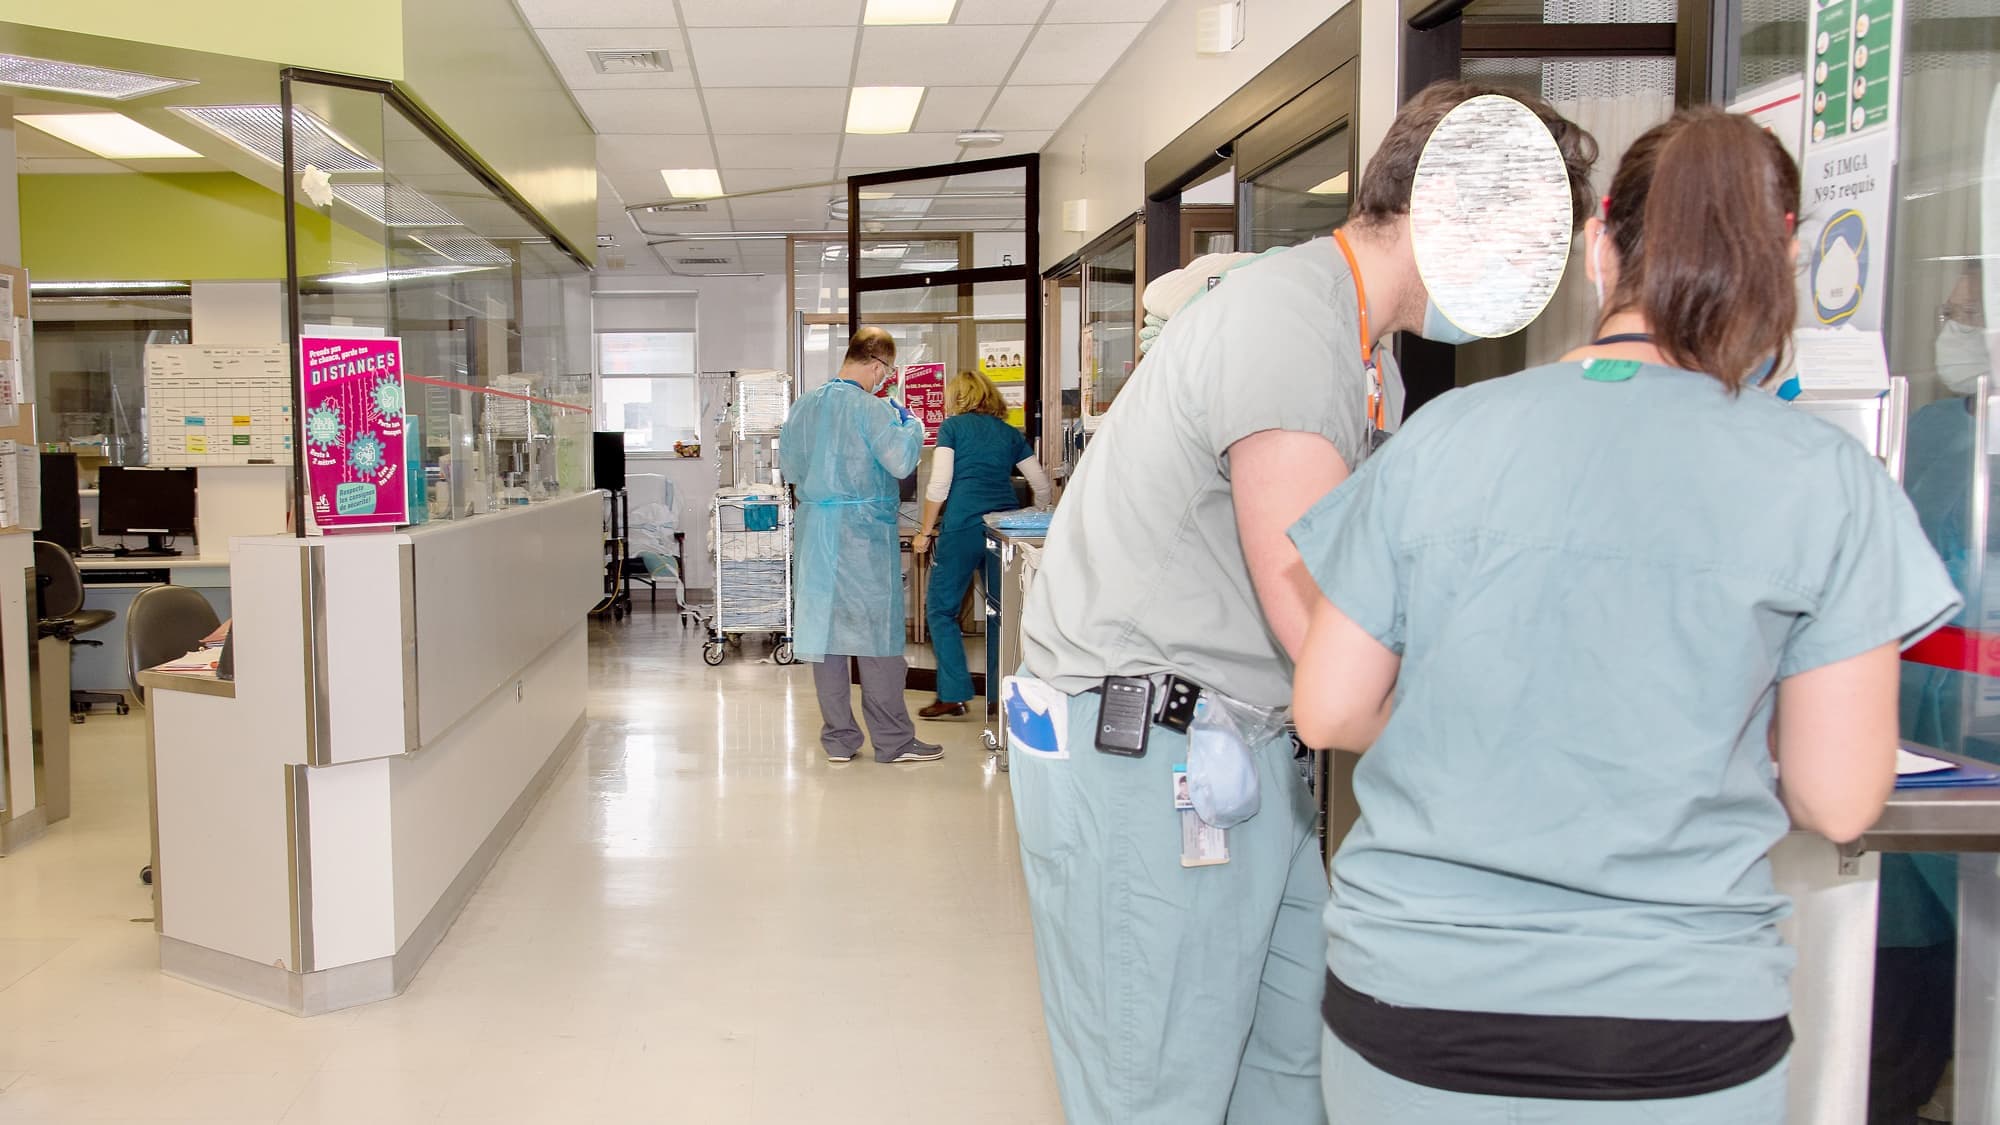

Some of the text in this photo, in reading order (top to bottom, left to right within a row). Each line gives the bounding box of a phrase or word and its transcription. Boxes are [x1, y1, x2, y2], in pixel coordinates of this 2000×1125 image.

[1823, 153, 1869, 179] Si IMGA
[1813, 175, 1876, 204] N95 requis
[1002, 254, 1013, 267] 5
[309, 346, 330, 358] Prends
[310, 351, 396, 386] DISTANCES
